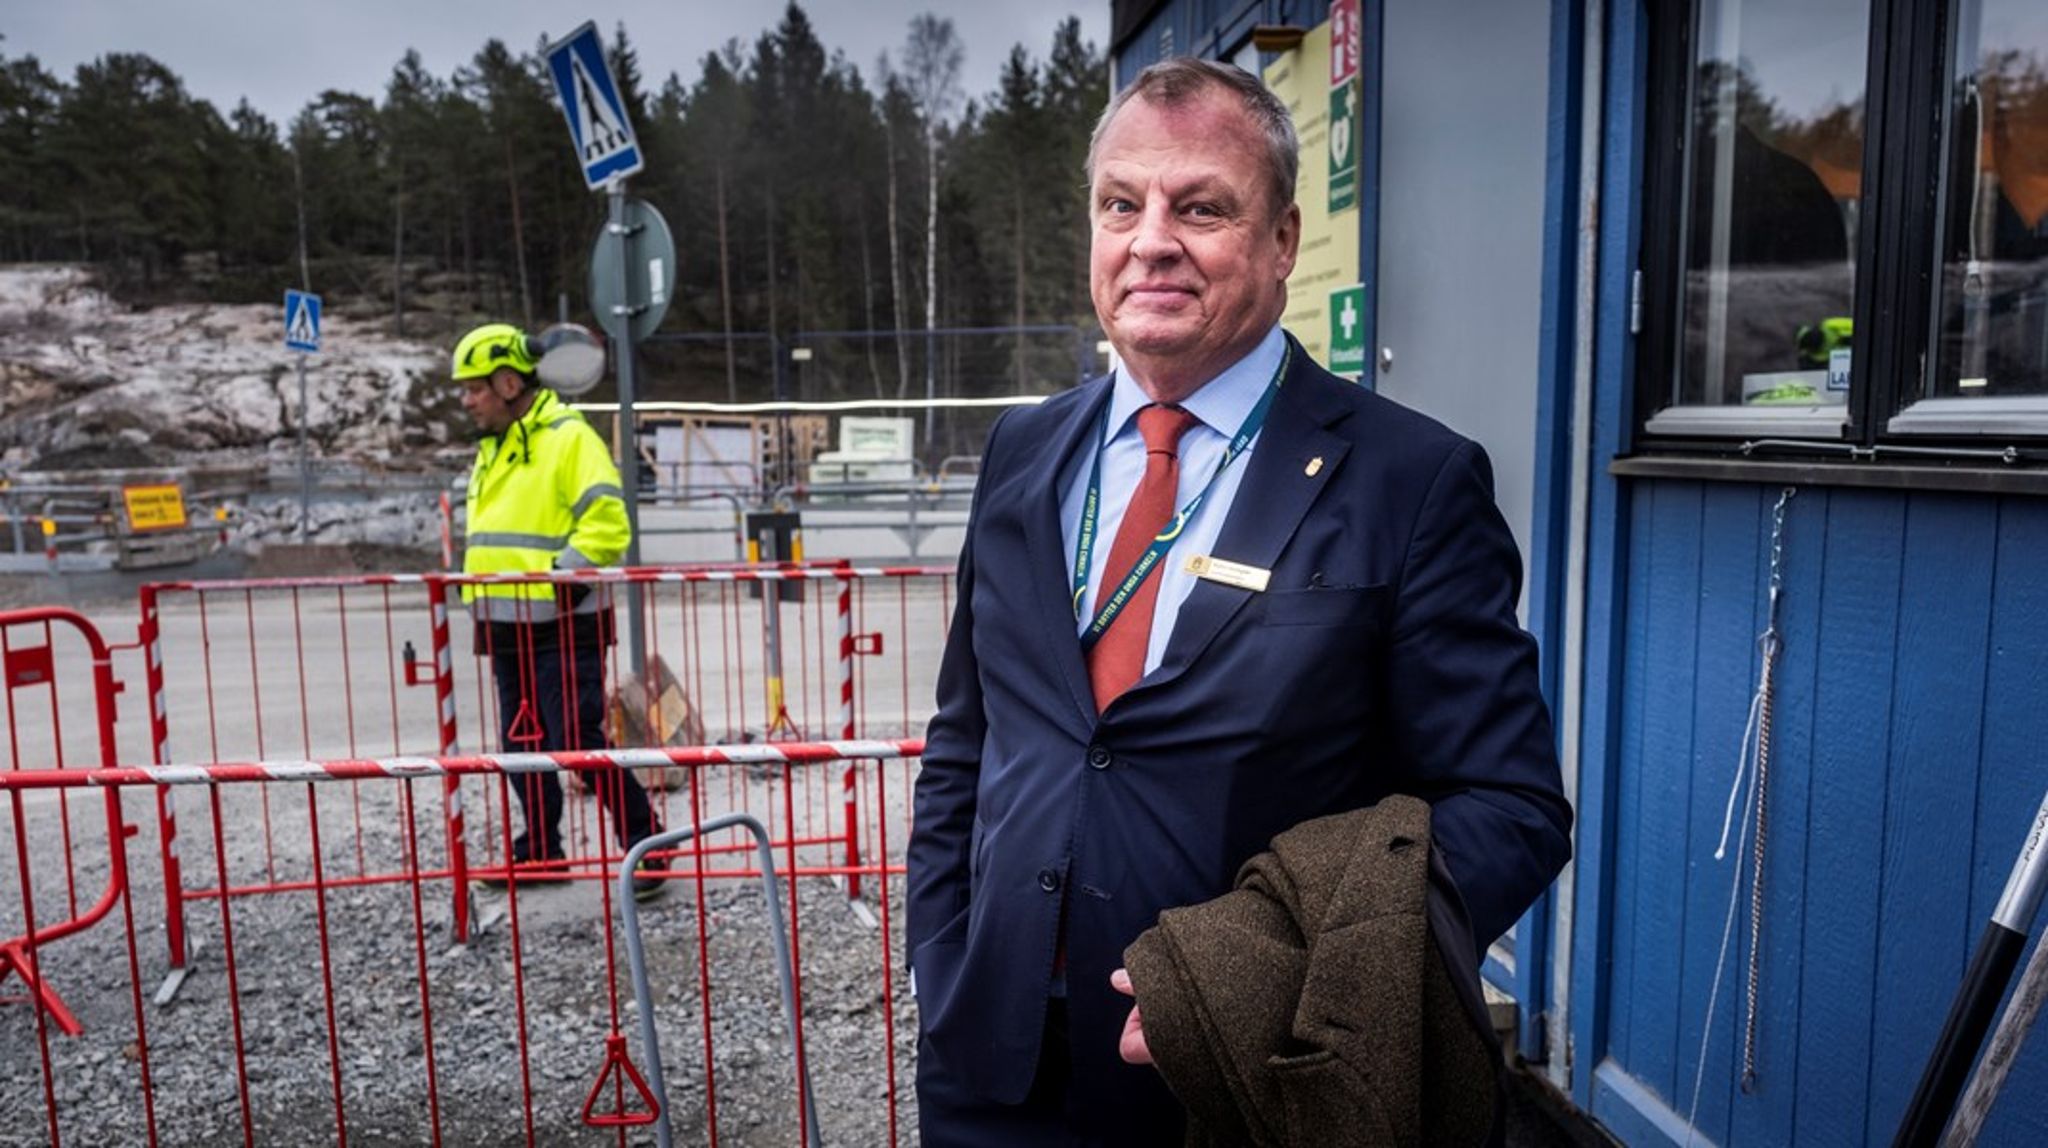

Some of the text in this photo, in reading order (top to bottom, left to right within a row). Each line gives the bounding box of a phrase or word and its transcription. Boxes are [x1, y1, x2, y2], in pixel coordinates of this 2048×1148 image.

[1113, 590, 1127, 605] DEN
[1123, 574, 1139, 592] ONDA
[1134, 550, 1158, 576] CIRKELN
